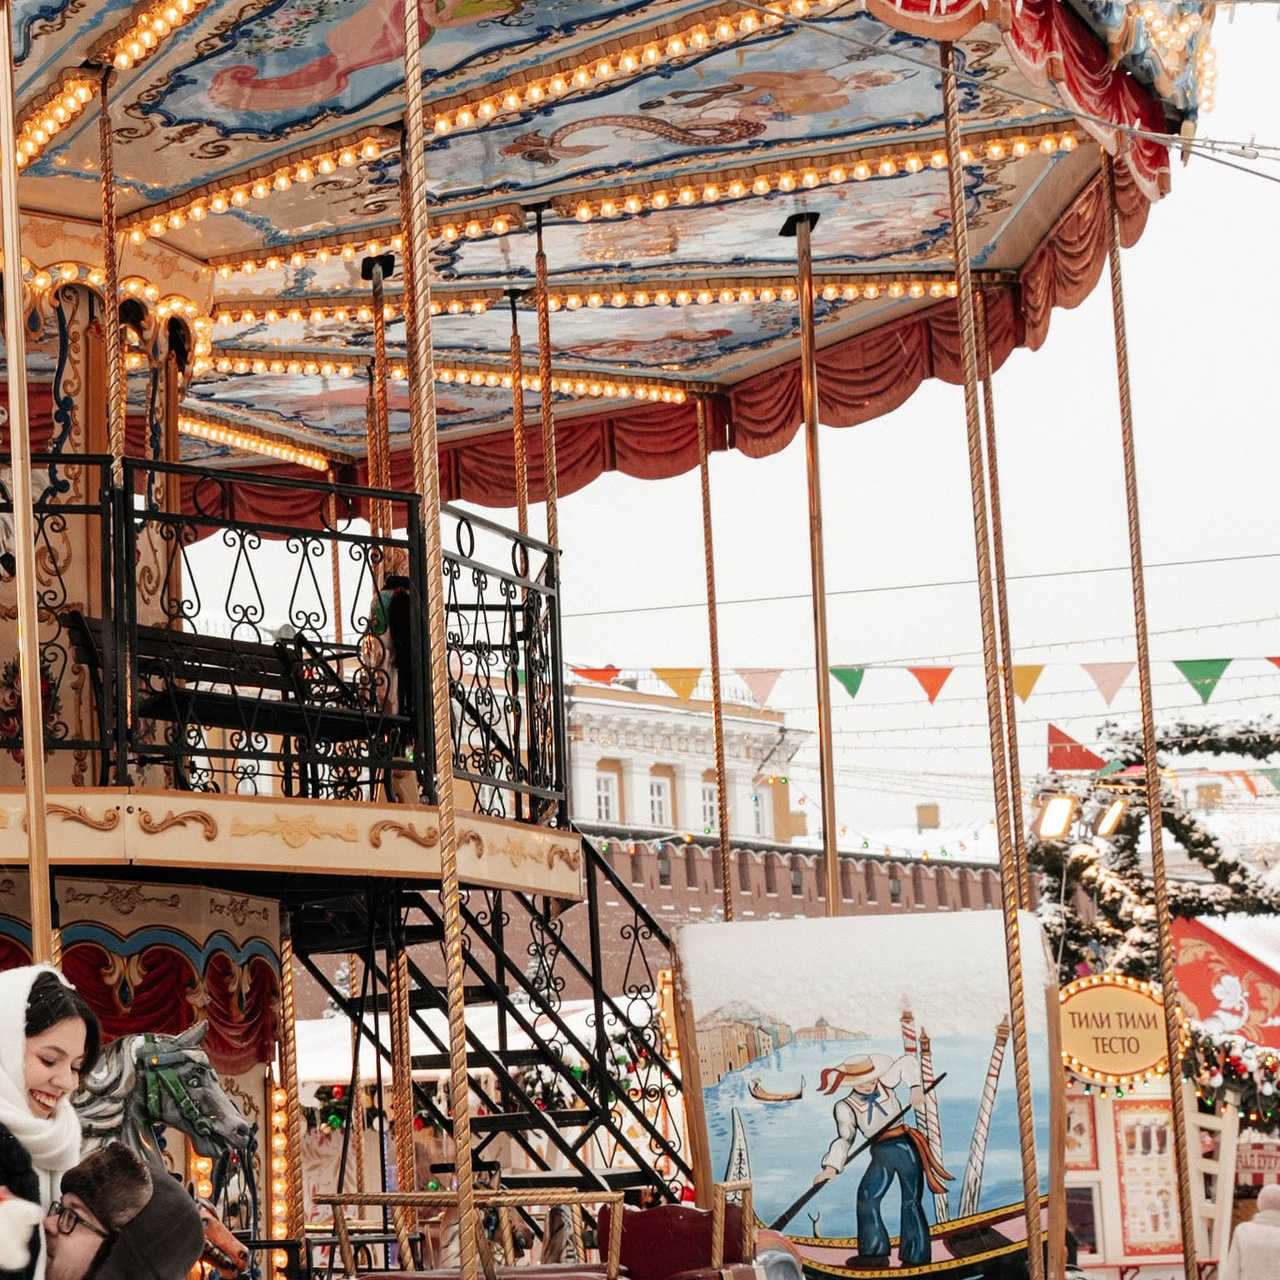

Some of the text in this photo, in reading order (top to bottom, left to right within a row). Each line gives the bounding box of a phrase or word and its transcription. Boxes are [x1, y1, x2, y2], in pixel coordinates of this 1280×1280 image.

[1068, 1012, 1158, 1029] ТИЛИ ТИЛИ
[1092, 1037, 1140, 1054] ТЕСТО
